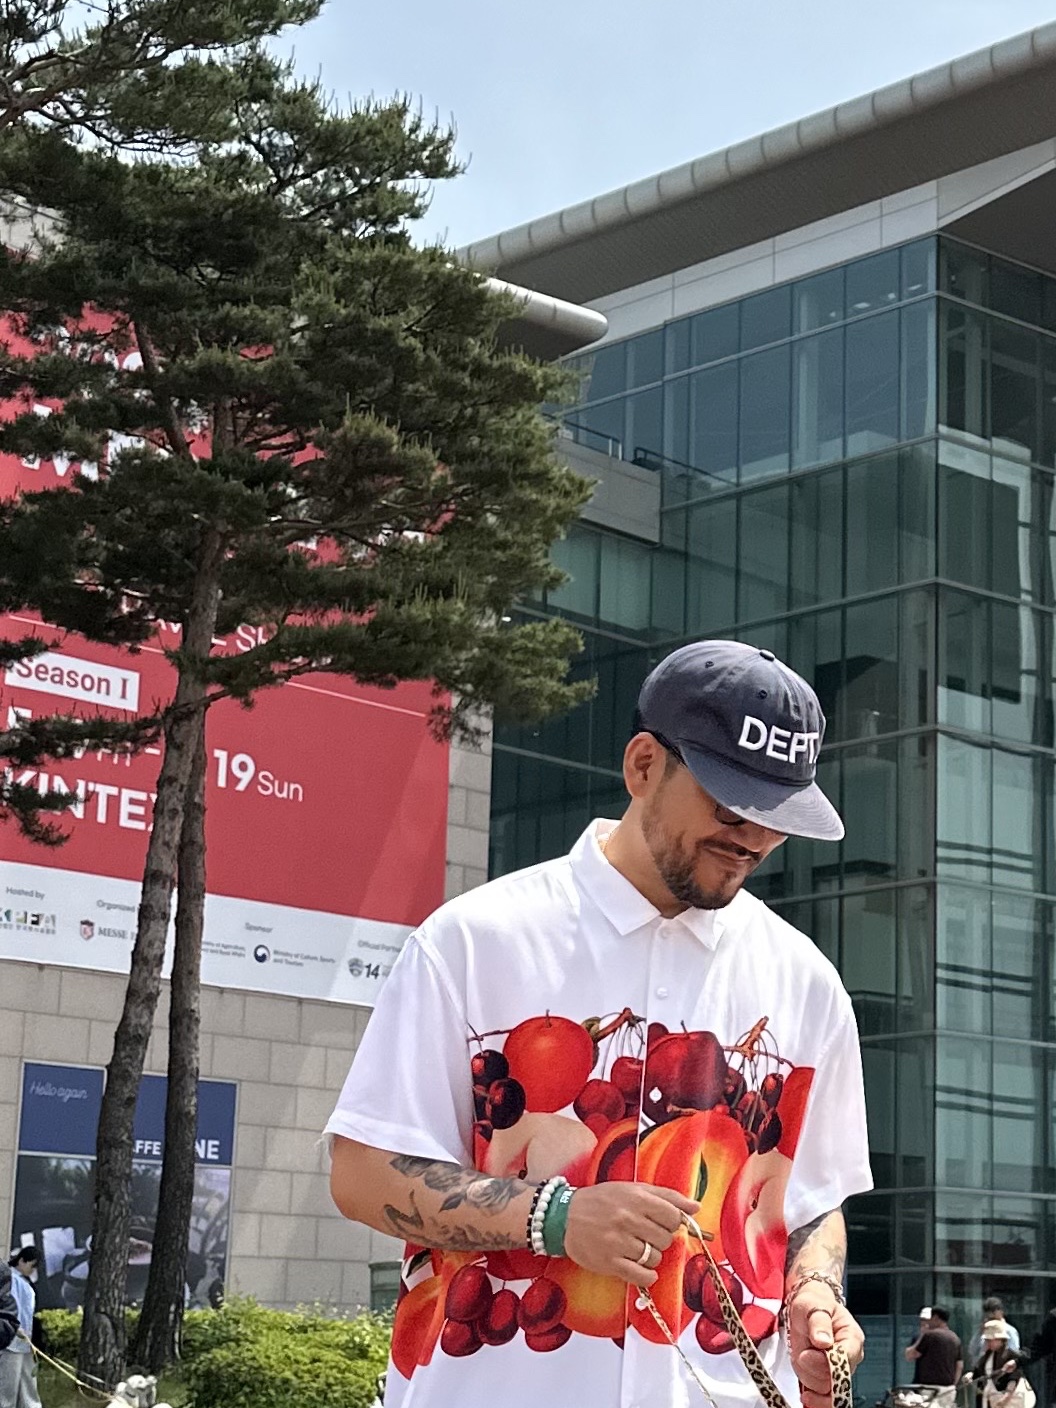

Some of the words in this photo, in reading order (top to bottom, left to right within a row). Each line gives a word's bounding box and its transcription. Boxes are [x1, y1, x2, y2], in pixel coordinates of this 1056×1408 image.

[16, 658, 111, 696] Season
[213, 748, 256, 792] 19
[257, 770, 304, 802] Sun
[3, 766, 158, 832] KINTE
[30, 1080, 57, 1096] Hello
